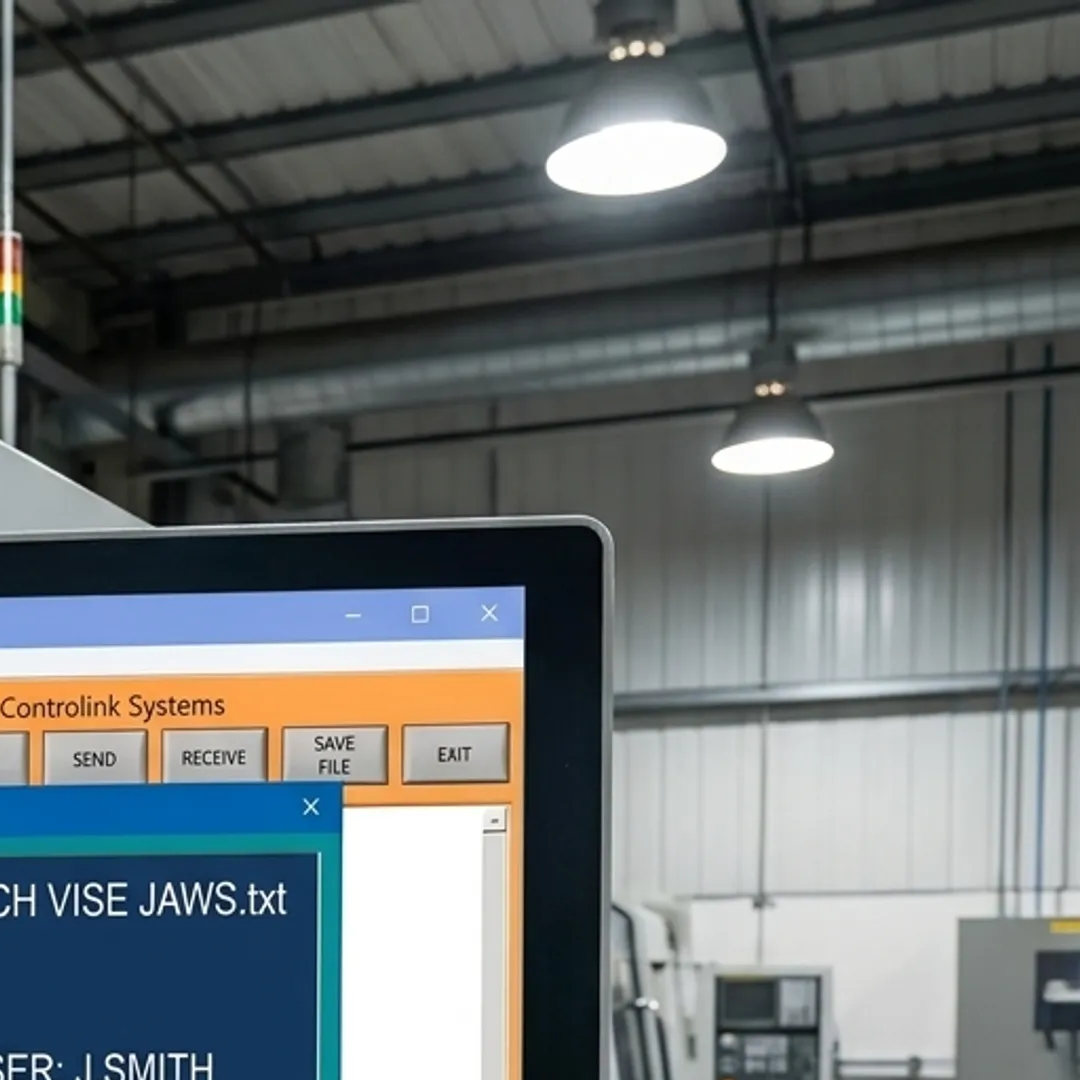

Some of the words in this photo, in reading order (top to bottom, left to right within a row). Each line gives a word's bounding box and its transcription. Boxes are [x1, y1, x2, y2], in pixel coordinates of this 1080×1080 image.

[0, 693, 121, 720] Controlink
[128, 693, 226, 724] Systems
[314, 734, 356, 753] SAVE
[72, 750, 118, 769] SEND
[180, 748, 248, 767] RECEIVE
[317, 757, 352, 777] FILE
[47, 881, 128, 917] VISE
[138, 880, 289, 917] JAWS.txt
